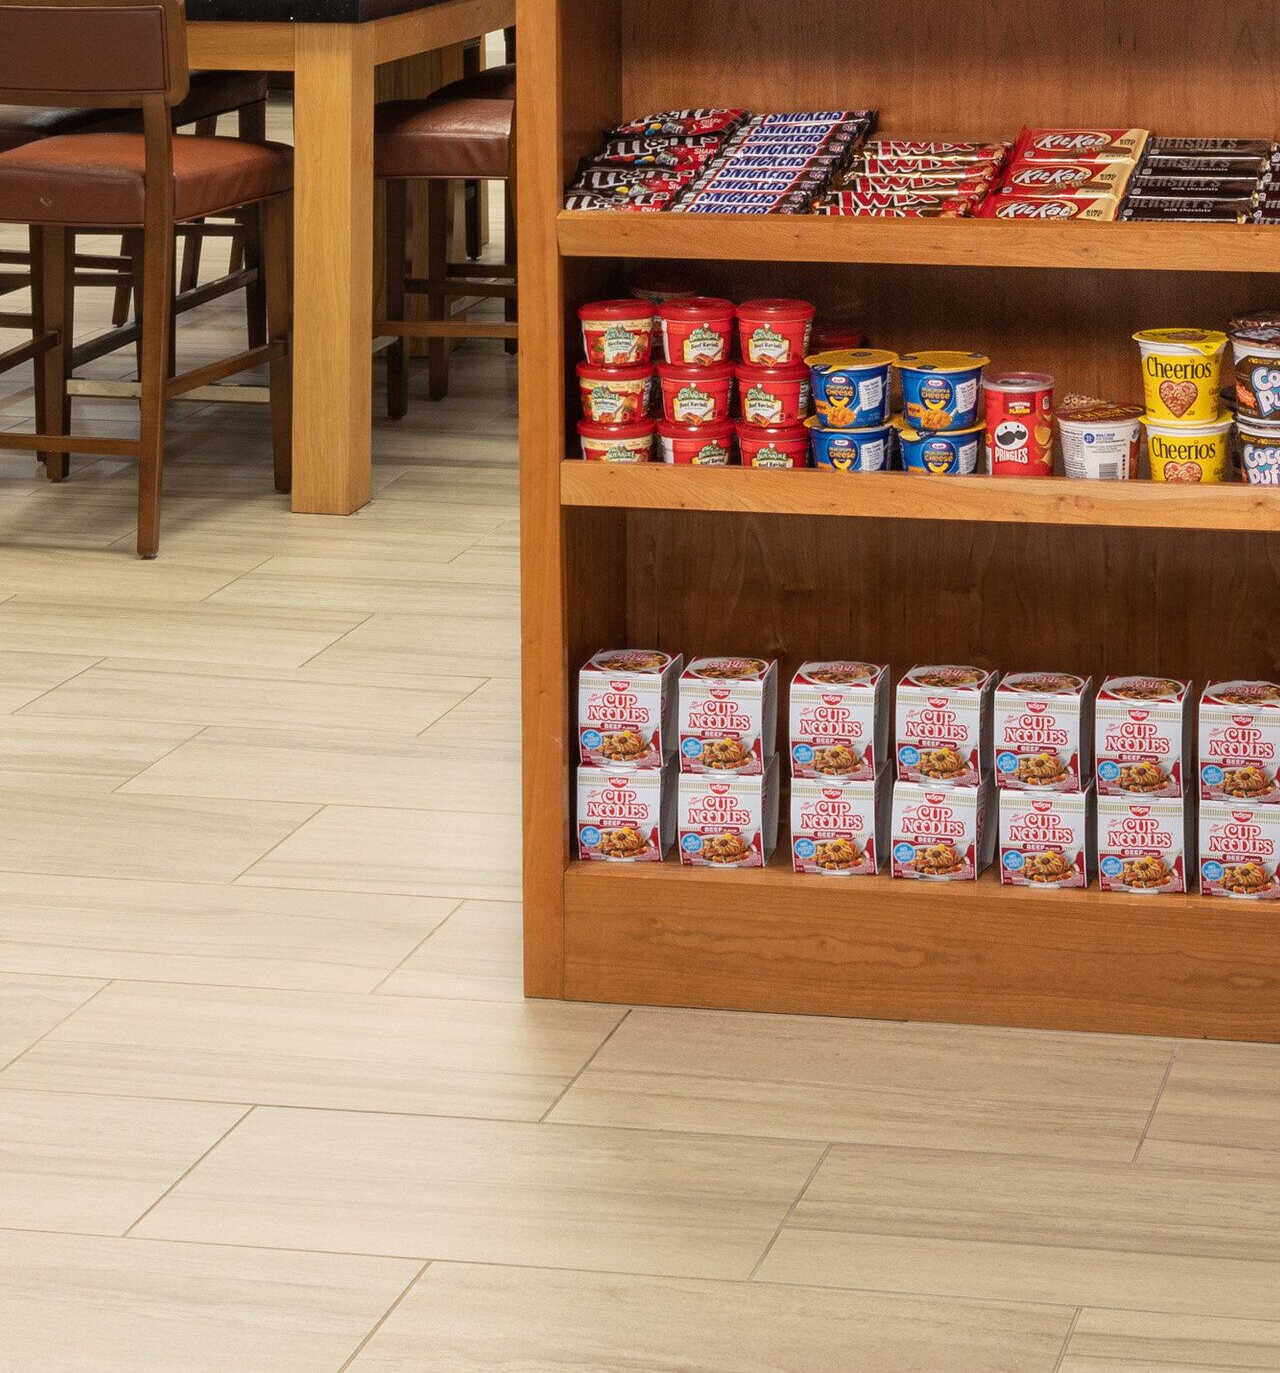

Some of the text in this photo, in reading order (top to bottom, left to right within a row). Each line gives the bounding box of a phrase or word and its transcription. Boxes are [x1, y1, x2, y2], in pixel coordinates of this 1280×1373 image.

[1146, 356, 1212, 380] Cheerios
[994, 446, 1029, 464] PRINGLES
[1151, 436, 1216, 460] Cheerios
[1225, 728, 1261, 743] CUP
[1106, 737, 1169, 753] NOODLES
[1210, 742, 1274, 758] NOODLES
[1123, 819, 1159, 833] CUP
[1225, 824, 1261, 838] CUP
[1010, 827, 1073, 843] NOODLES
[1109, 832, 1171, 848] NOODLES
[1210, 837, 1273, 854] NOODLES
